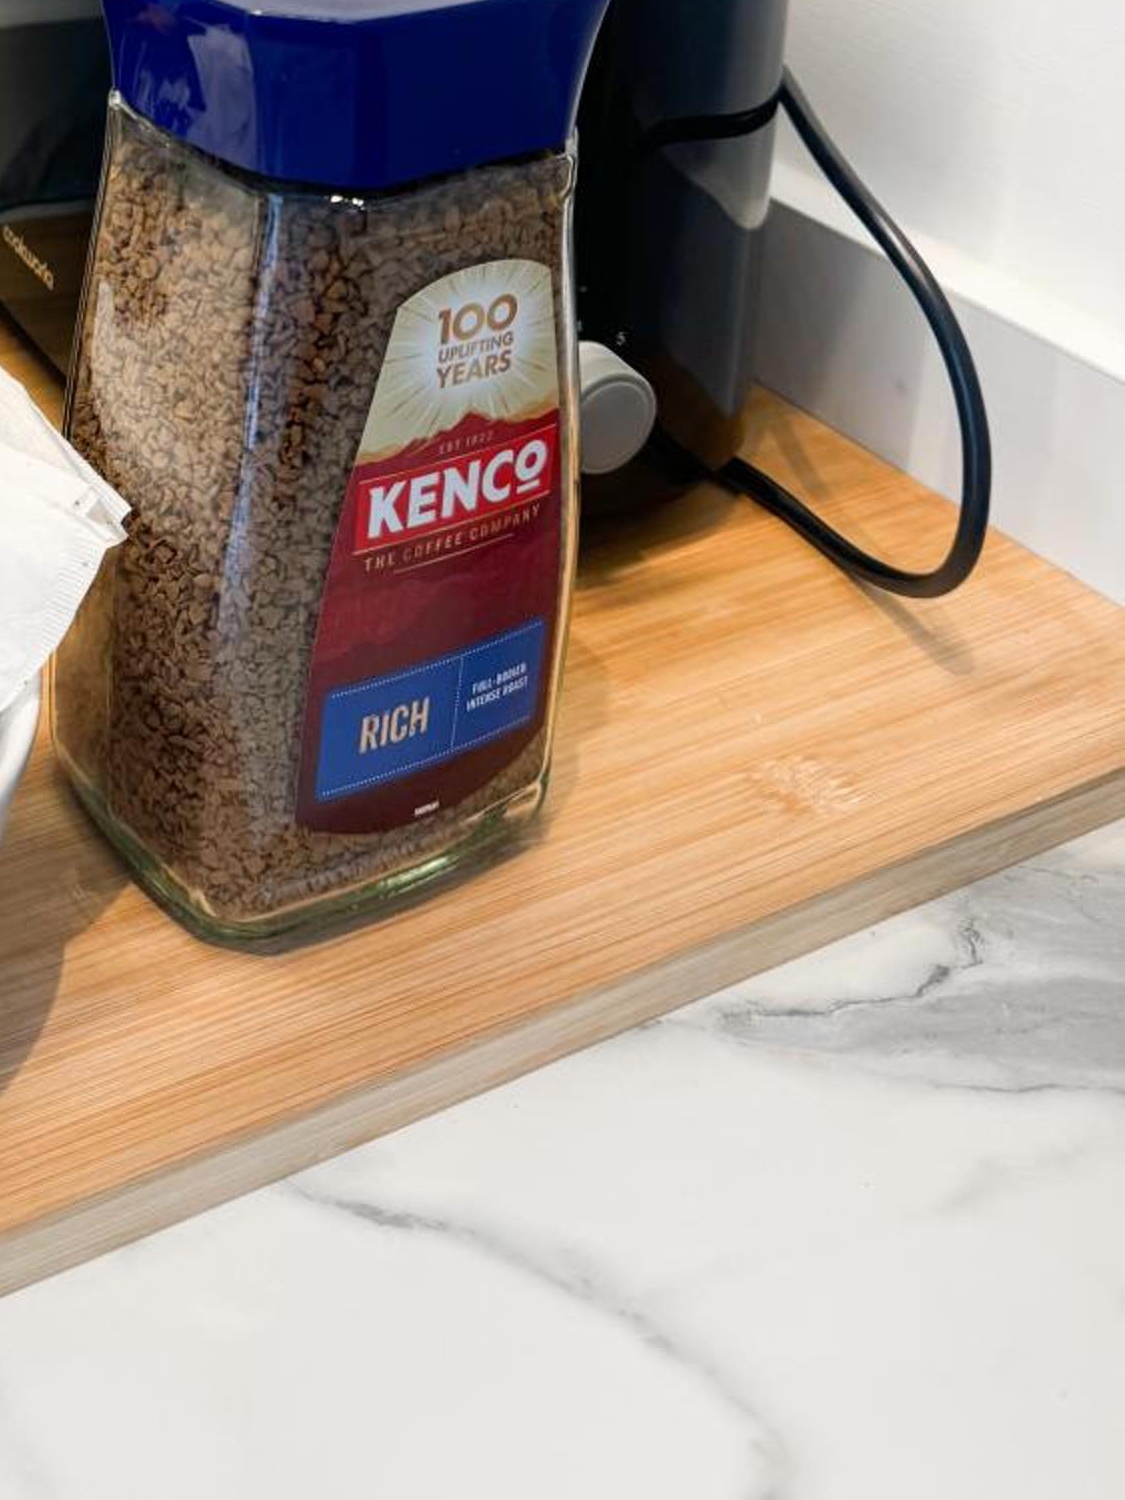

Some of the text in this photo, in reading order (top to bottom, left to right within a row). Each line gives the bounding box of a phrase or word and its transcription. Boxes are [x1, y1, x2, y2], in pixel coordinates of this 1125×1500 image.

[437, 293, 518, 345] 100
[436, 350, 512, 388] YEARS
[437, 332, 515, 363] UPLIFTING
[365, 503, 540, 572] THE COFFEE COMPANY
[359, 697, 430, 754] RICH
